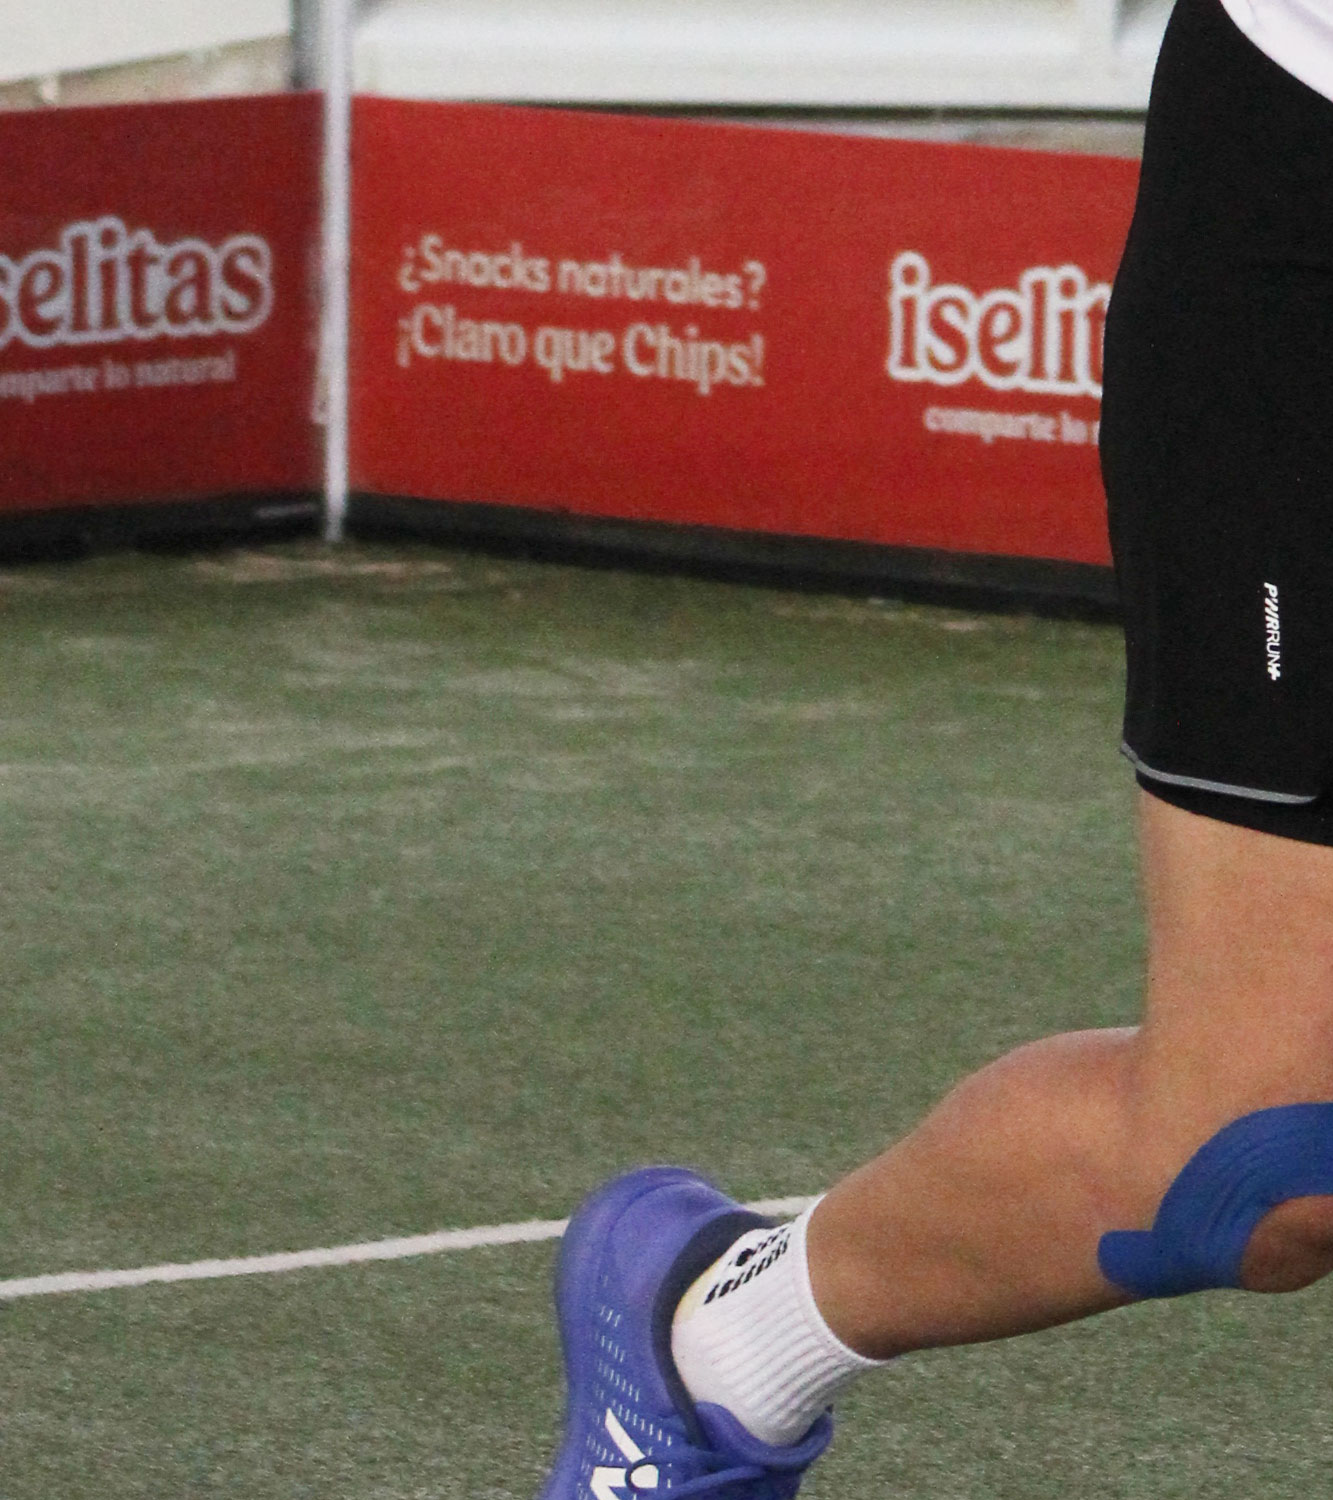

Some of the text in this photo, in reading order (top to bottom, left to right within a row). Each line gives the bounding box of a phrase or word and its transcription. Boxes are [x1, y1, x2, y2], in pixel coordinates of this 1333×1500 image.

[398, 233, 767, 311] ¿Snacks naturales?
[396, 304, 765, 396] ¡Claro que Chips!
